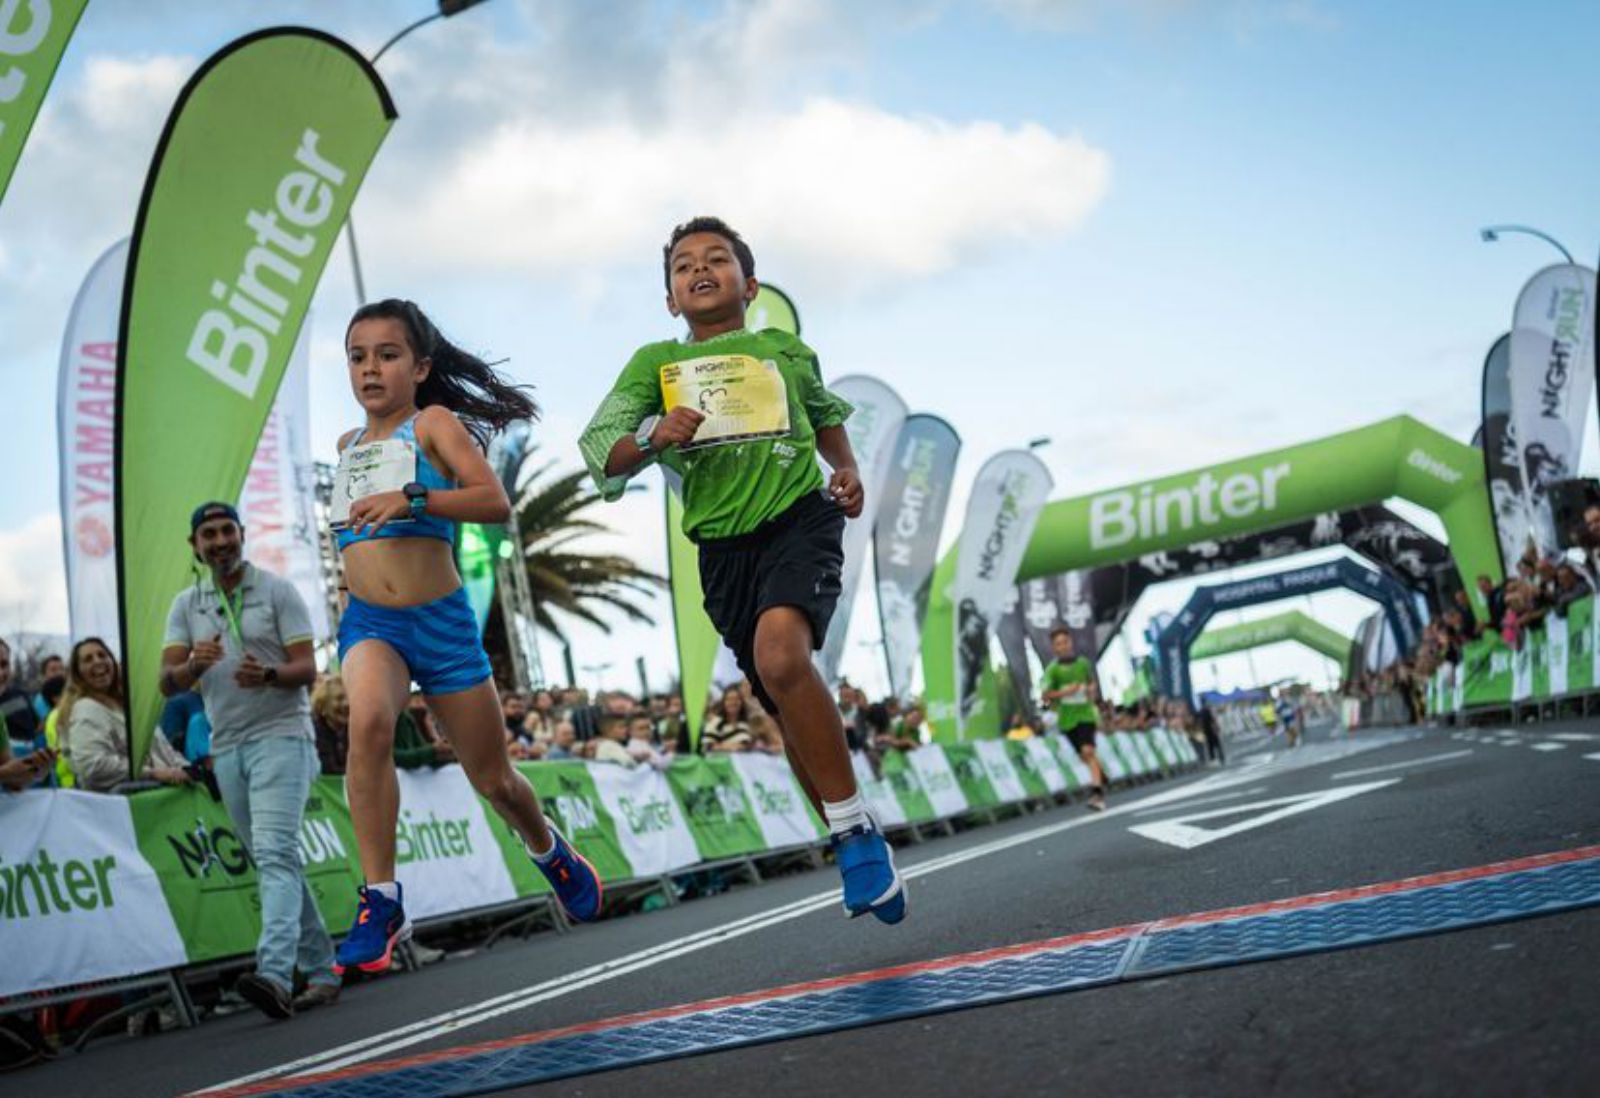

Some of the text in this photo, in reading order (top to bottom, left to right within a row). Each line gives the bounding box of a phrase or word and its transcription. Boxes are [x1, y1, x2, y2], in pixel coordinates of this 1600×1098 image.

[186, 128, 347, 399] Binter
[76, 341, 117, 509] YAMAHA
[1089, 462, 1290, 550] Binter
[396, 810, 473, 864] Binter
[0, 850, 116, 918] inter
